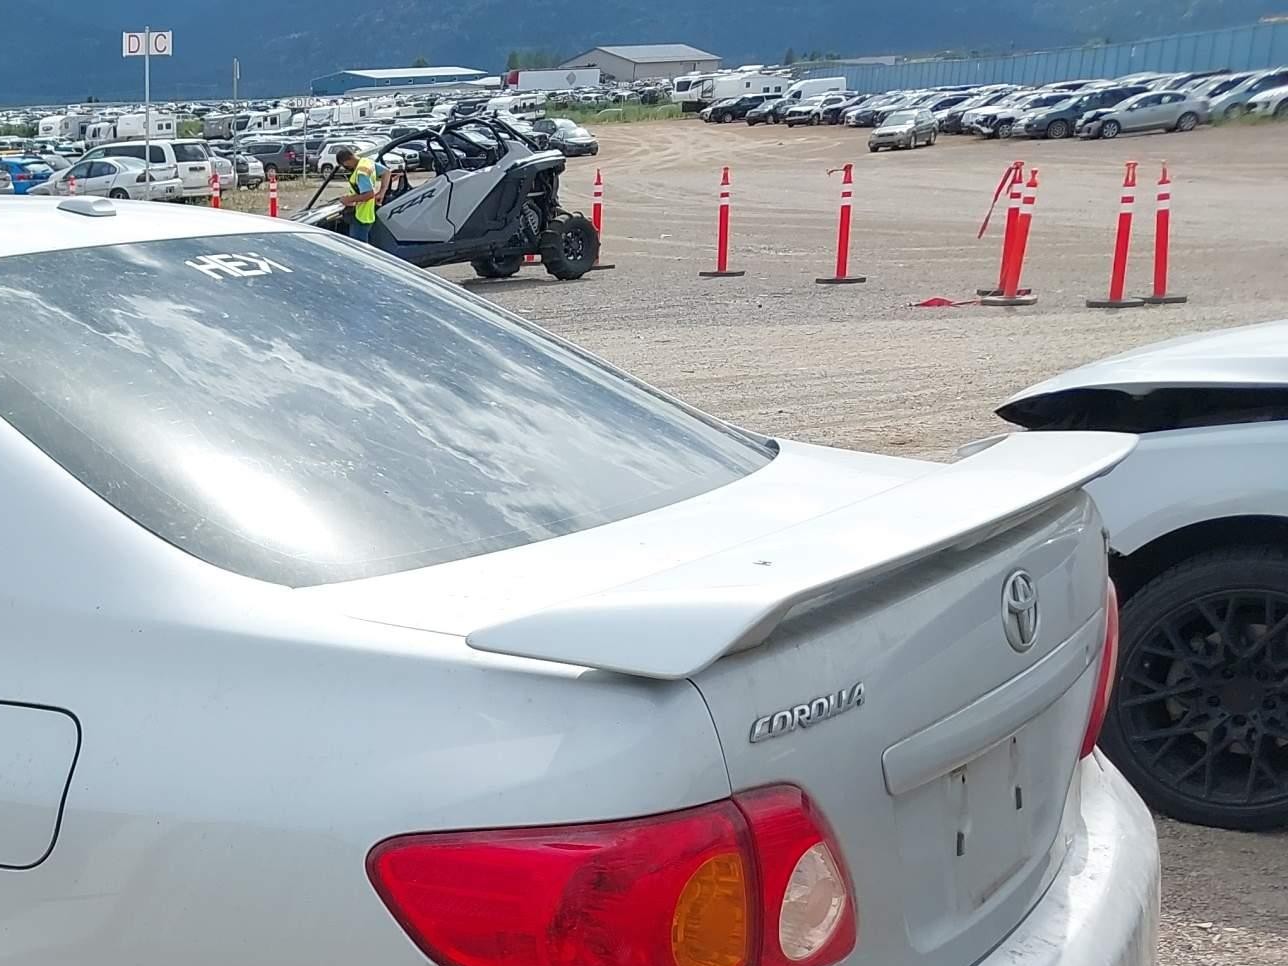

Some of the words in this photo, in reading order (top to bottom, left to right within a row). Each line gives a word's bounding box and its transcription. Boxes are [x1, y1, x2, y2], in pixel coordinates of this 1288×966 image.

[127, 34, 141, 53] D
[154, 33, 168, 53] C
[387, 187, 437, 221] RZR
[749, 681, 866, 744] COROLLA
